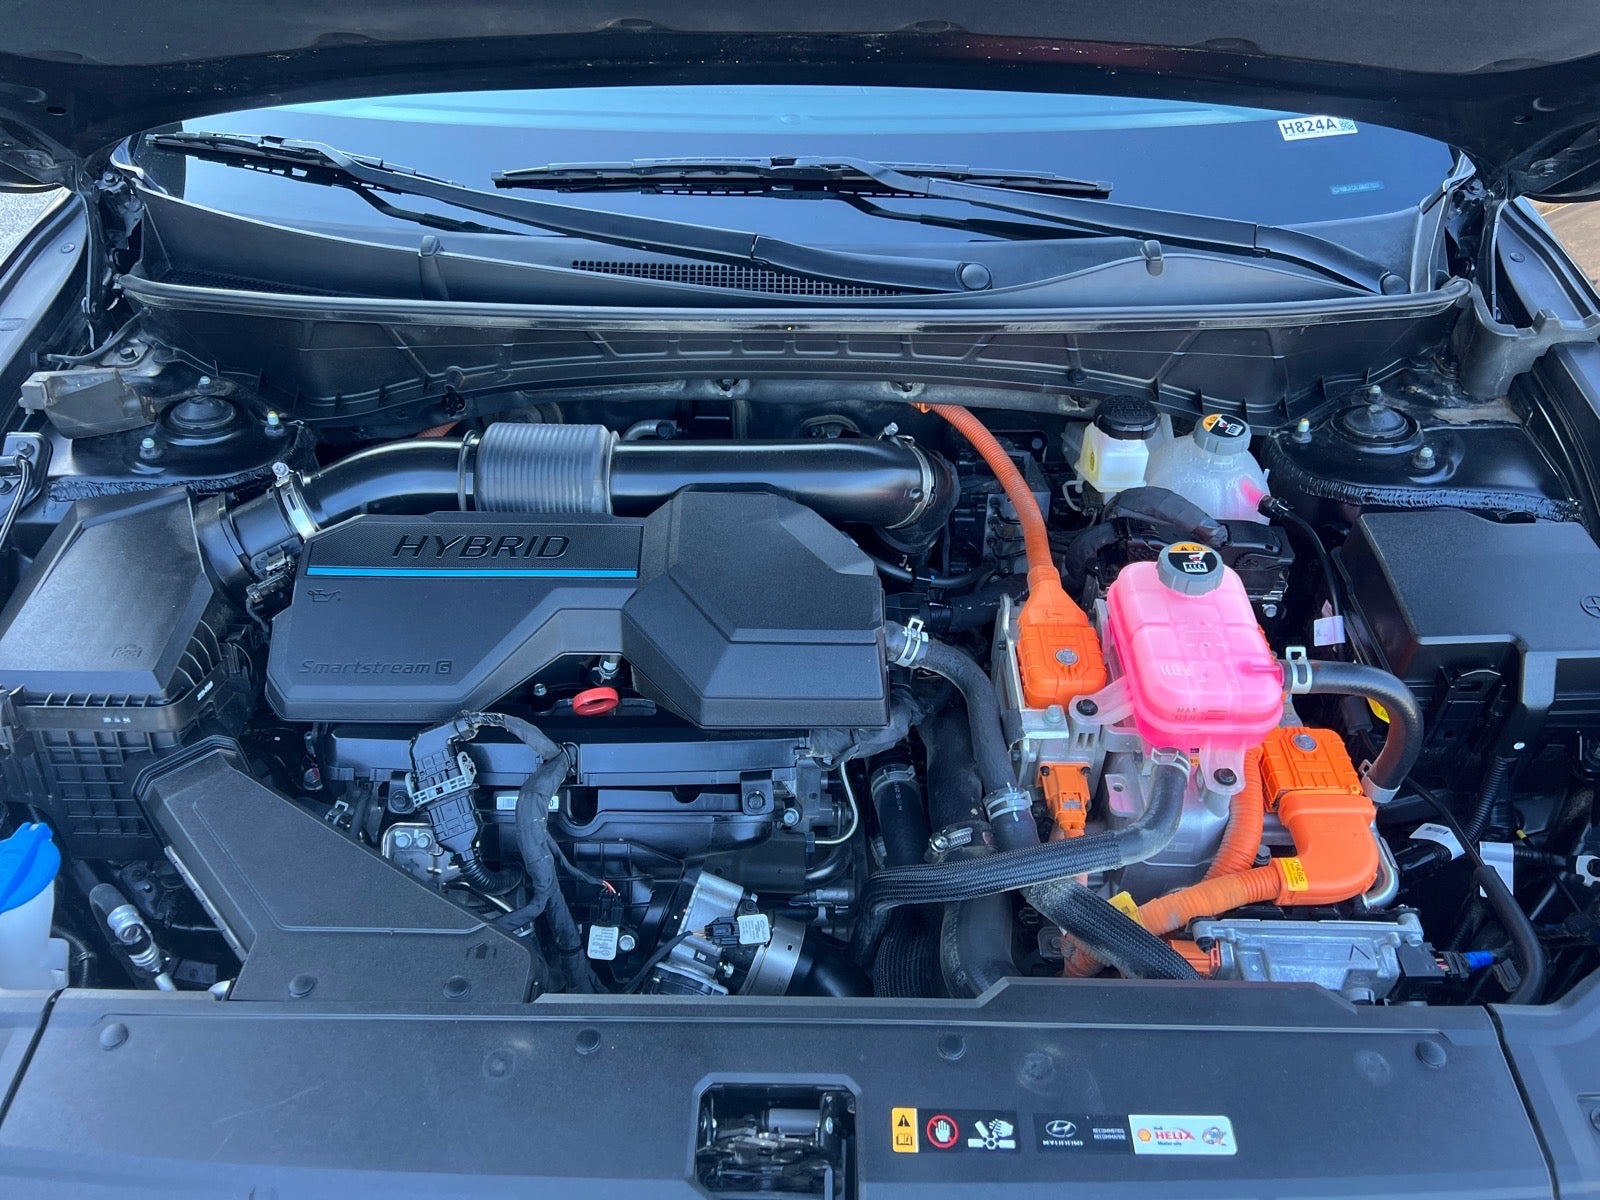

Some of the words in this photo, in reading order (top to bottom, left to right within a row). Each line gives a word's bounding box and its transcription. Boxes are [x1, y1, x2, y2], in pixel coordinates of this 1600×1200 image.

[1282, 118, 1337, 135] H824A
[391, 534, 570, 559] HYBRID
[299, 660, 430, 675] Smartstream
[435, 660, 453, 675] G
[1155, 1131, 1194, 1140] HELIX
